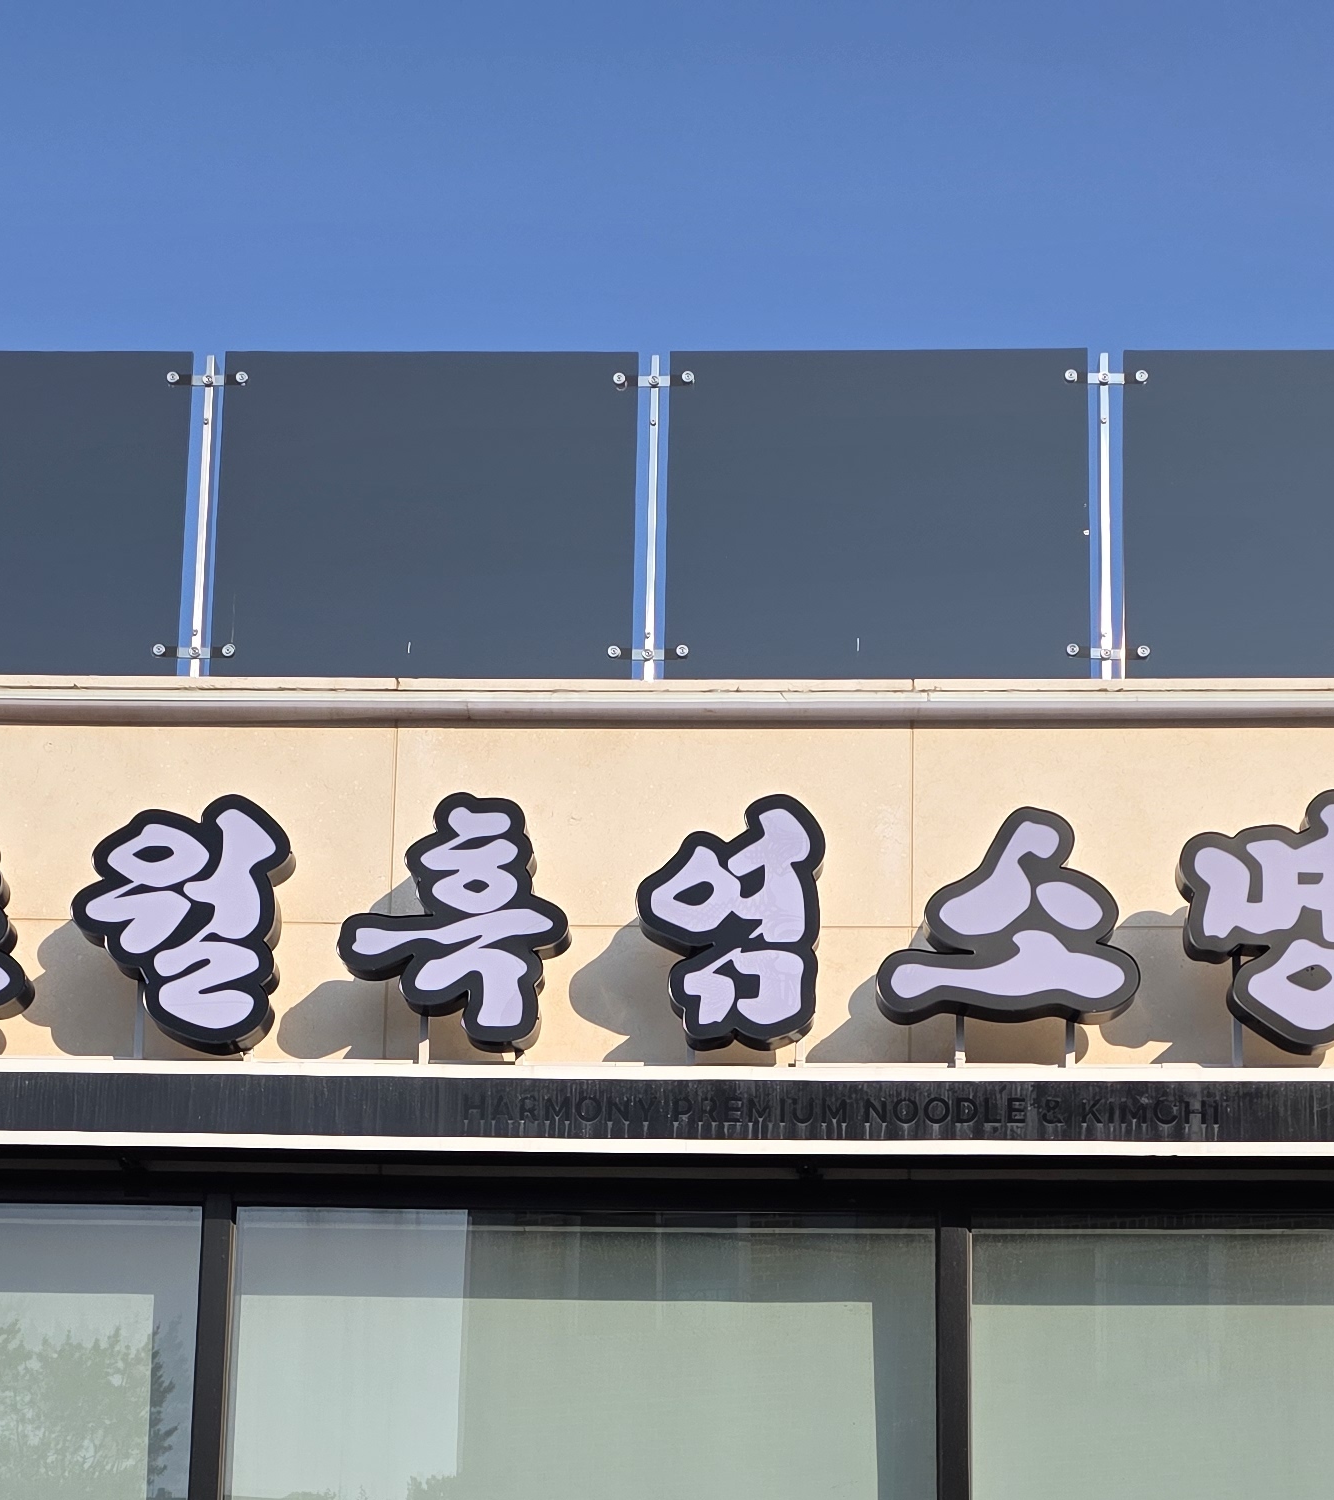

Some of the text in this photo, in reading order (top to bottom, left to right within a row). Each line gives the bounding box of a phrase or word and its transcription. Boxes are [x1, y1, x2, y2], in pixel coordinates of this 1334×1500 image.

[463, 1095, 657, 1124] HARMONY
[672, 1095, 848, 1124] PREMIUM
[864, 1095, 1028, 1125] NOODLE
[1081, 1095, 1220, 1124] KIMCHI
